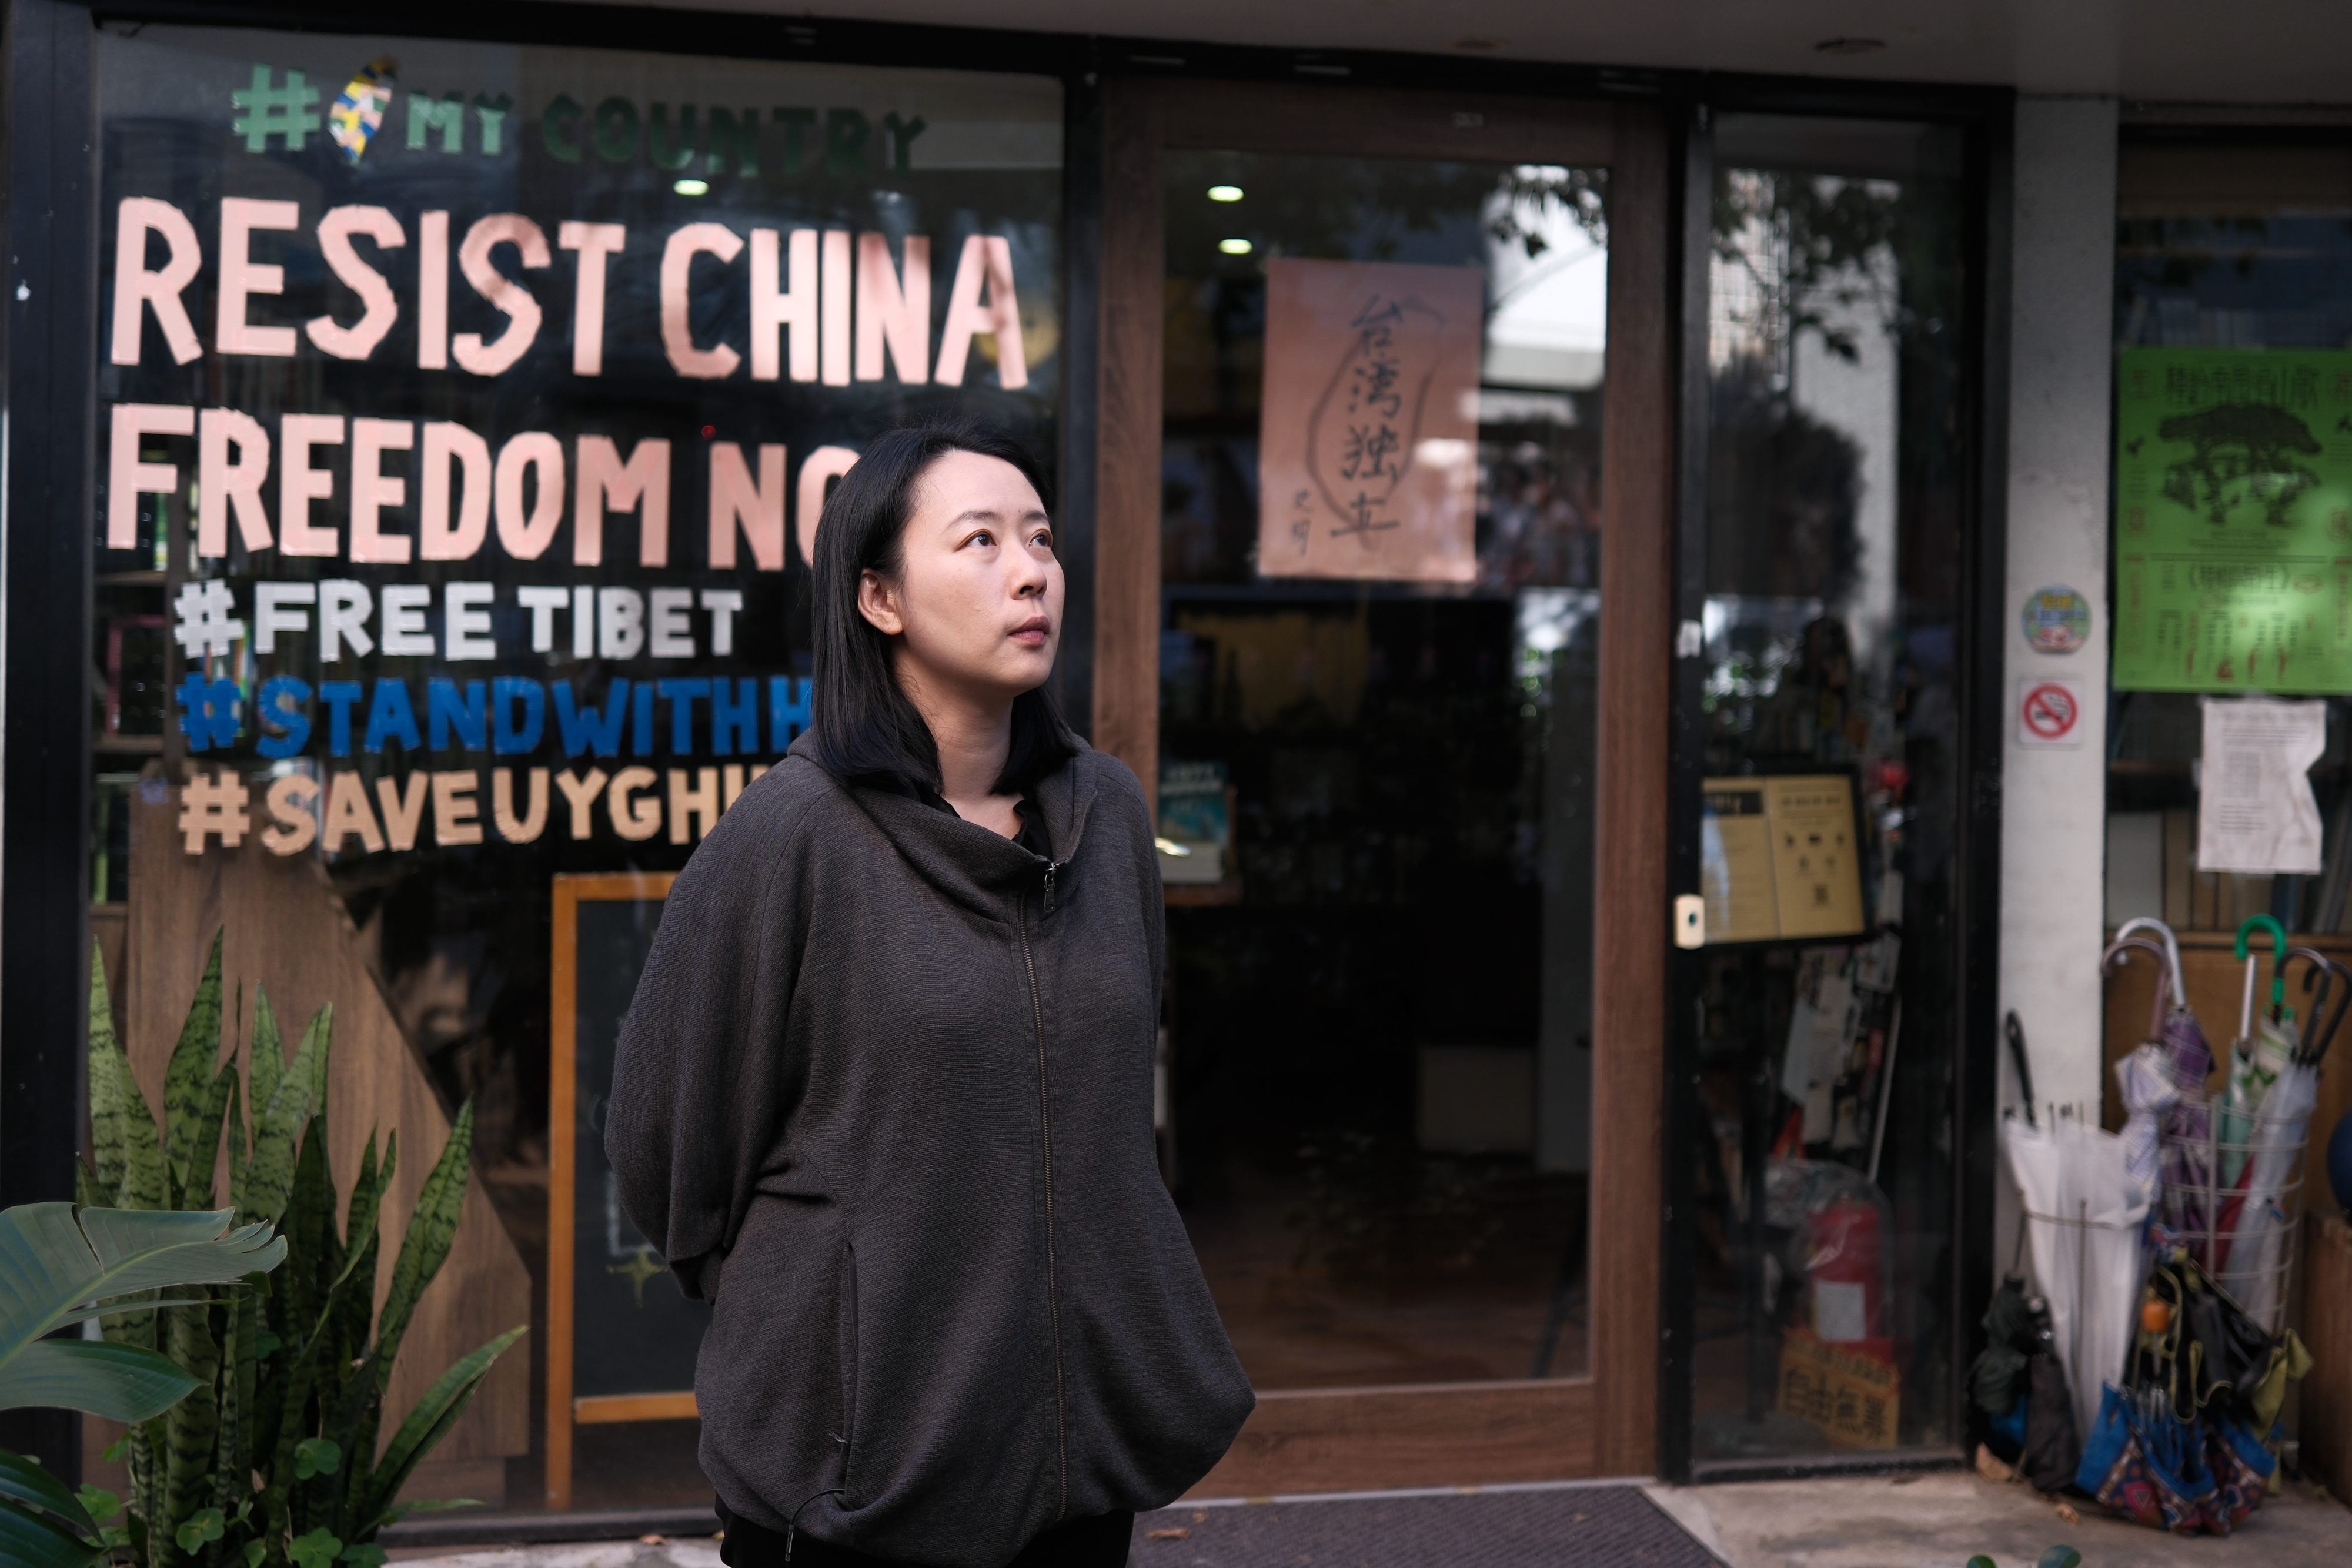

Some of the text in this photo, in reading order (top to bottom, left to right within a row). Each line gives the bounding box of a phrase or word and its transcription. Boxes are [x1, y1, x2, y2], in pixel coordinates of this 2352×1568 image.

[233, 62, 925, 177] # MY COUNTRY
[112, 196, 1028, 390] RESIST CHINA
[107, 403, 671, 569] FREEDOM
[517, 585, 743, 660] TIBET
